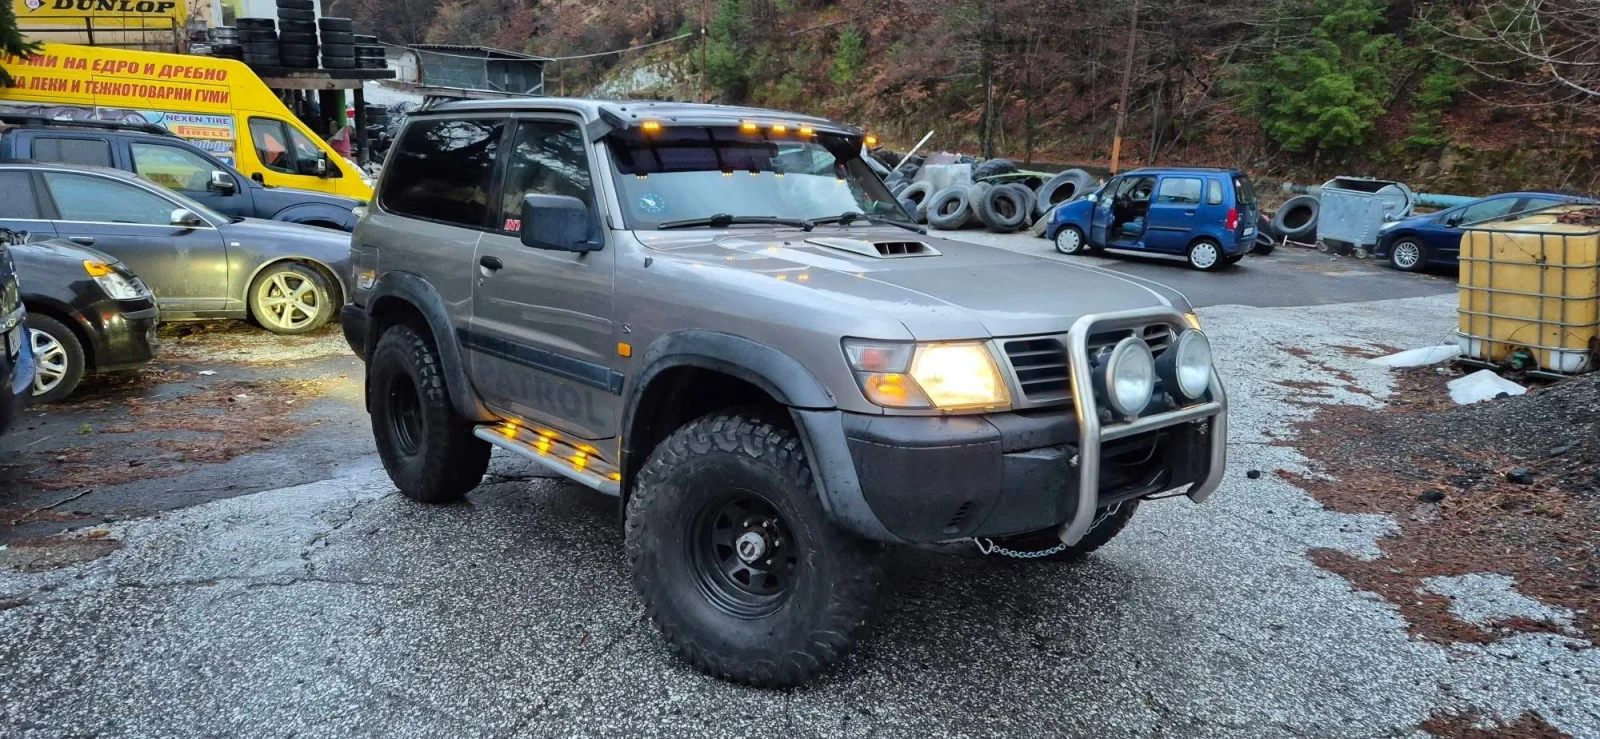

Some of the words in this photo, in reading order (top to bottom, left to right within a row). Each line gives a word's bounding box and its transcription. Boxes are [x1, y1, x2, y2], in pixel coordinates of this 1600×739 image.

[52, 0, 175, 13] DUNLOP
[63, 57, 87, 70] НА
[92, 59, 139, 74] ЕДРО
[143, 63, 155, 76] И
[158, 64, 227, 81] ДРЕБНО
[29, 77, 67, 92] ЛЕКИ
[71, 80, 81, 93] И
[85, 80, 192, 101] ТЕЖКОТОВАРНИ
[194, 89, 229, 104] ГУМИ
[165, 114, 203, 123] NEXEN
[478, 356, 606, 428] PATROL
